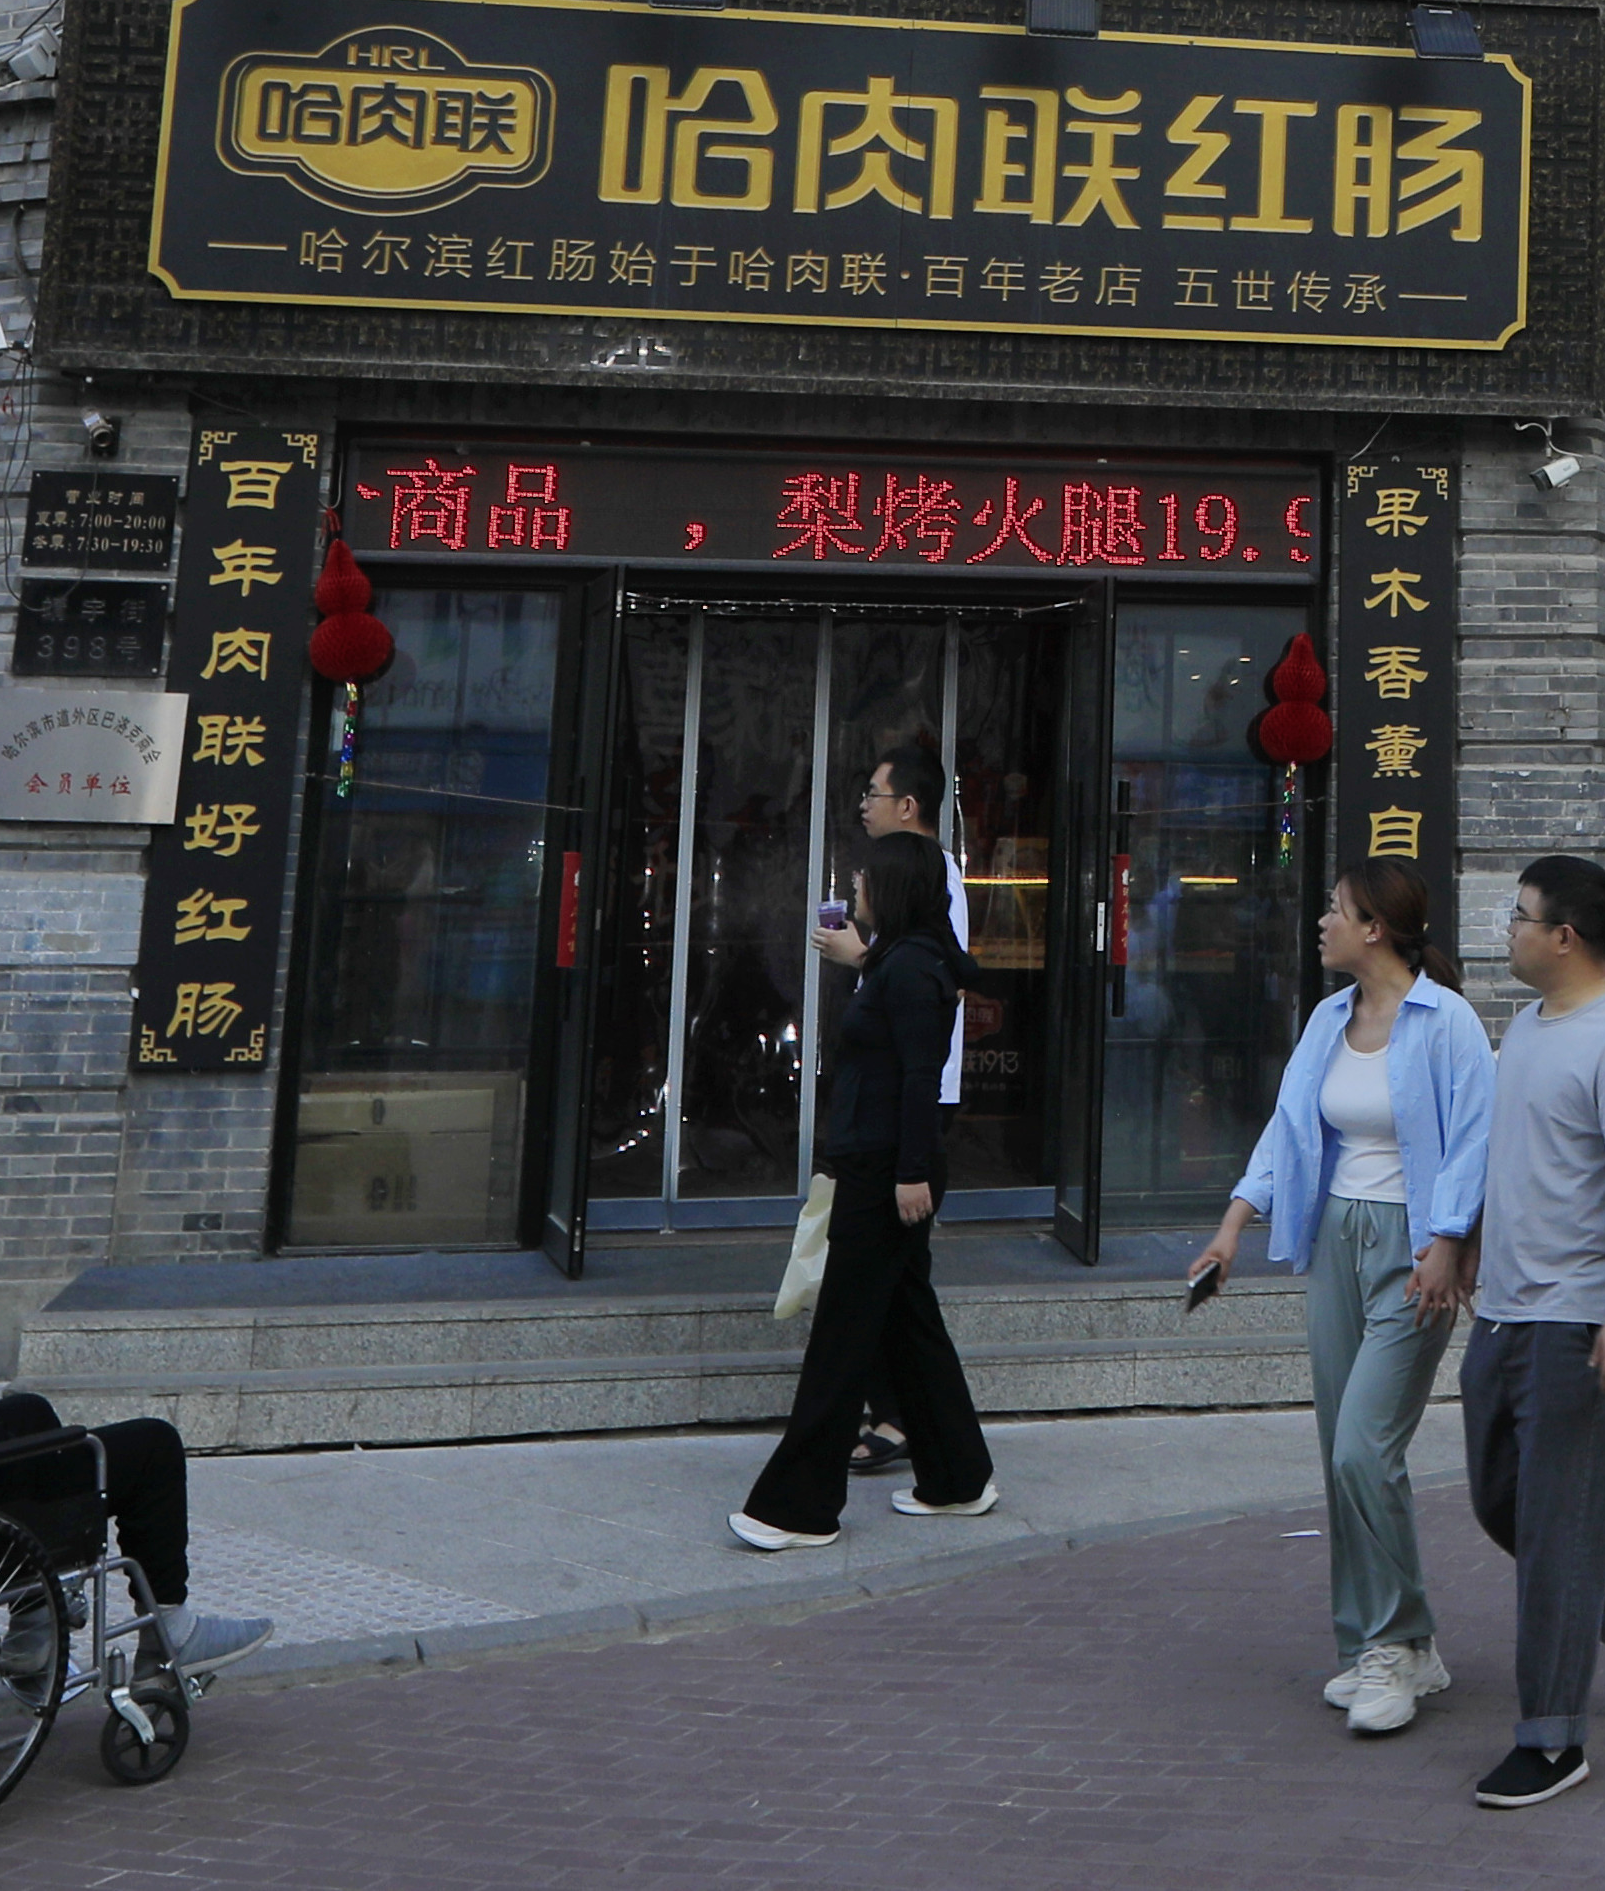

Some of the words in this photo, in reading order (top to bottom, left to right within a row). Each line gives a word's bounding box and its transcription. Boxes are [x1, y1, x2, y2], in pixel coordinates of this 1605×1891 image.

[347, 43, 445, 72] HRL
[256, 80, 518, 155] 哈肉联
[597, 64, 1483, 243] 哈肉联红肠
[1175, 267, 1387, 315] 五世传承
[384, 459, 572, 551] 商品
[24, 772, 132, 798] 会员单位
[166, 461, 293, 1039] 百年肉联好红肠
